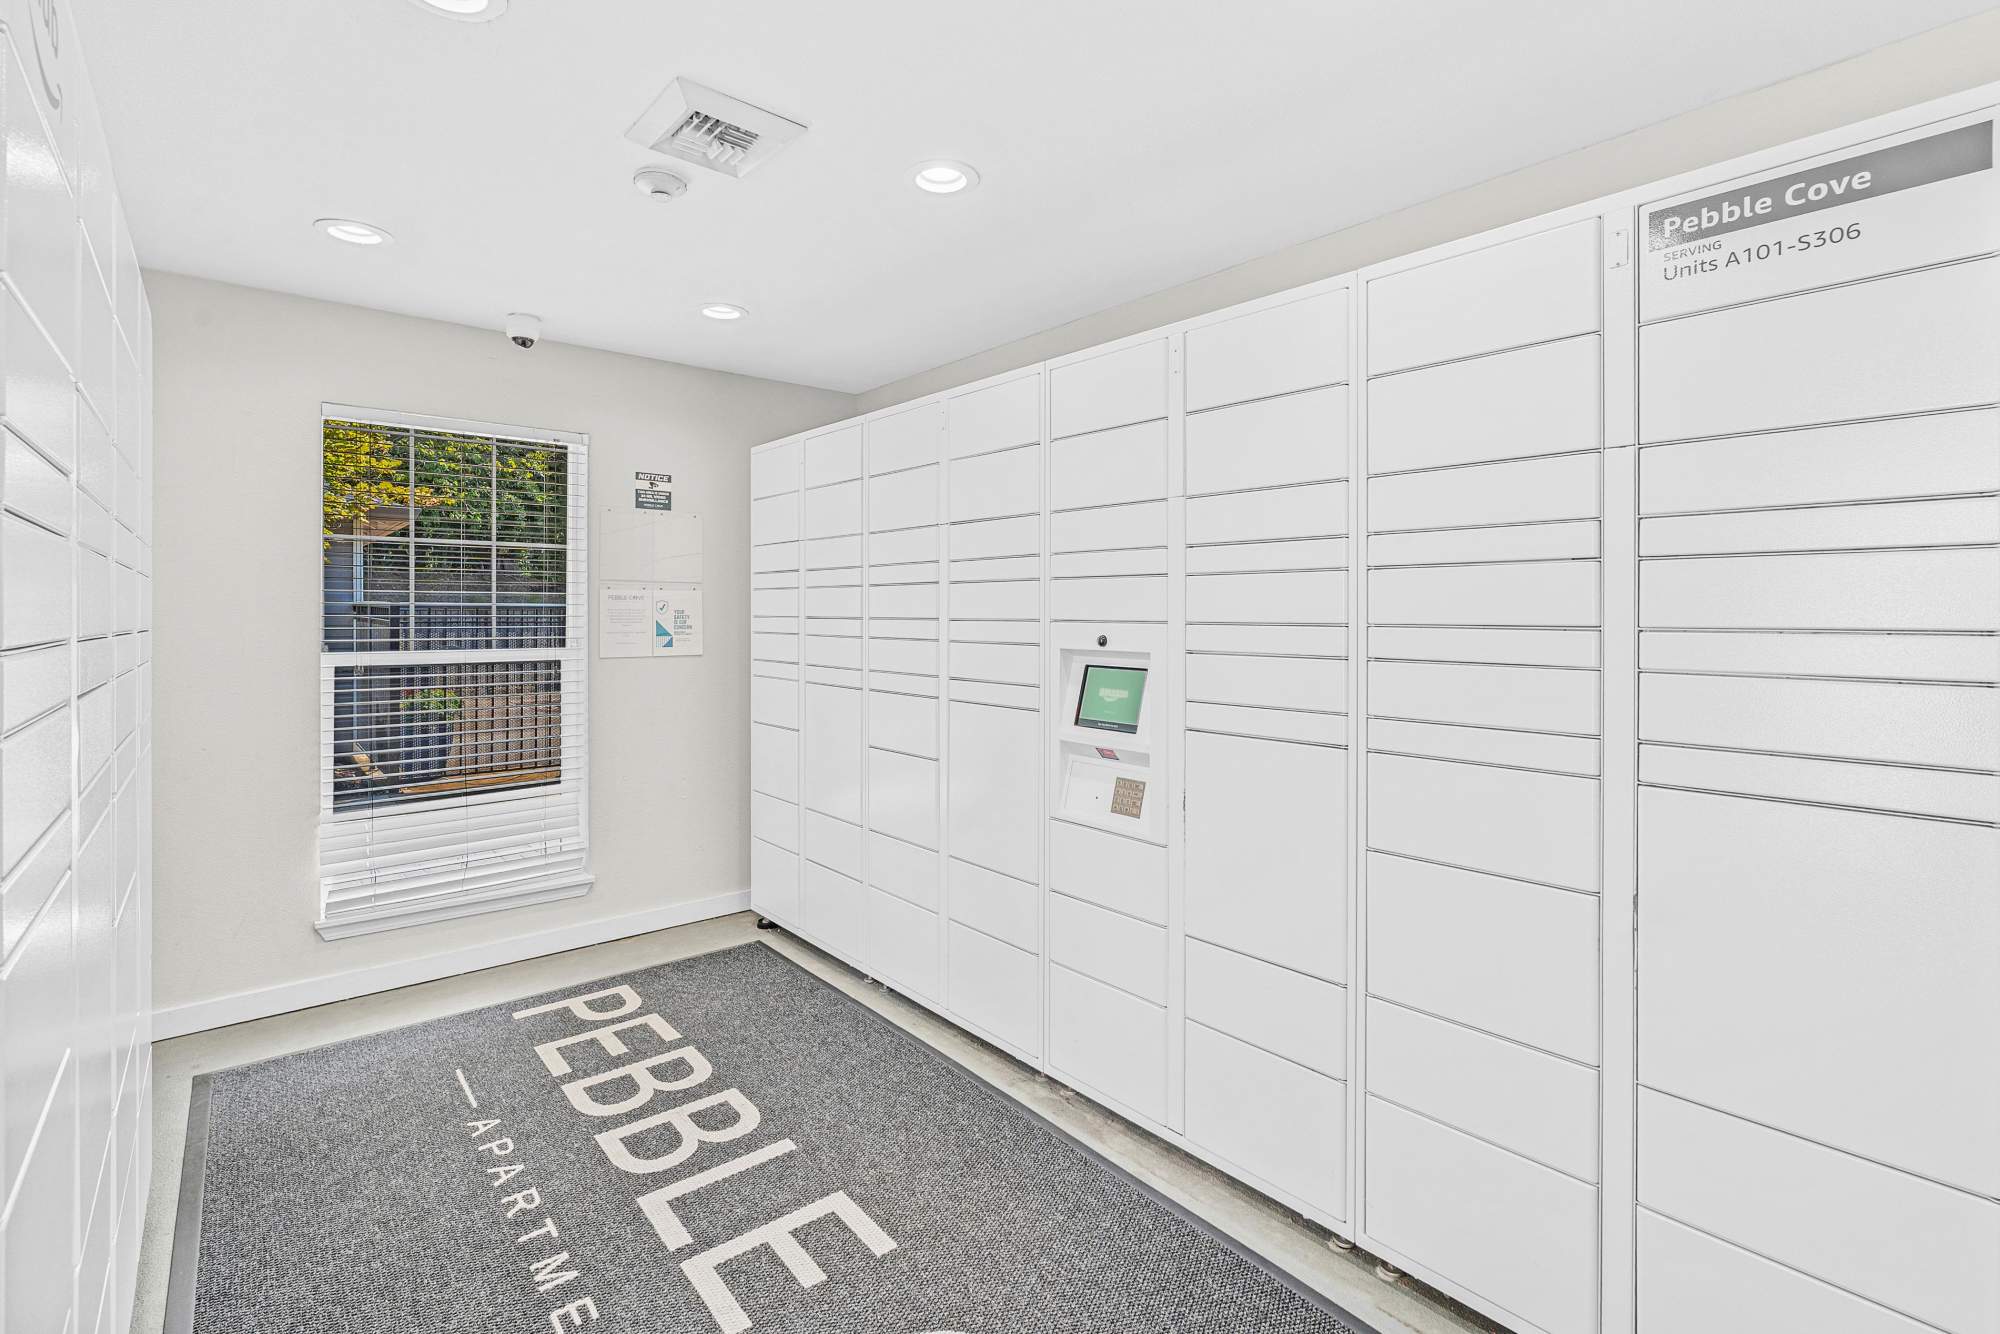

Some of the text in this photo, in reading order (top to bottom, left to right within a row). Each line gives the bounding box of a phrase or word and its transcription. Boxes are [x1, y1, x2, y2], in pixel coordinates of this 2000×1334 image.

[1663, 170, 1872, 238] Pebble Cove
[1663, 240, 1722, 263] SERVING
[1663, 222, 1861, 281] Units A101-S306
[638, 473, 669, 482] NOTICE
[512, 984, 898, 1334] PEBBLE
